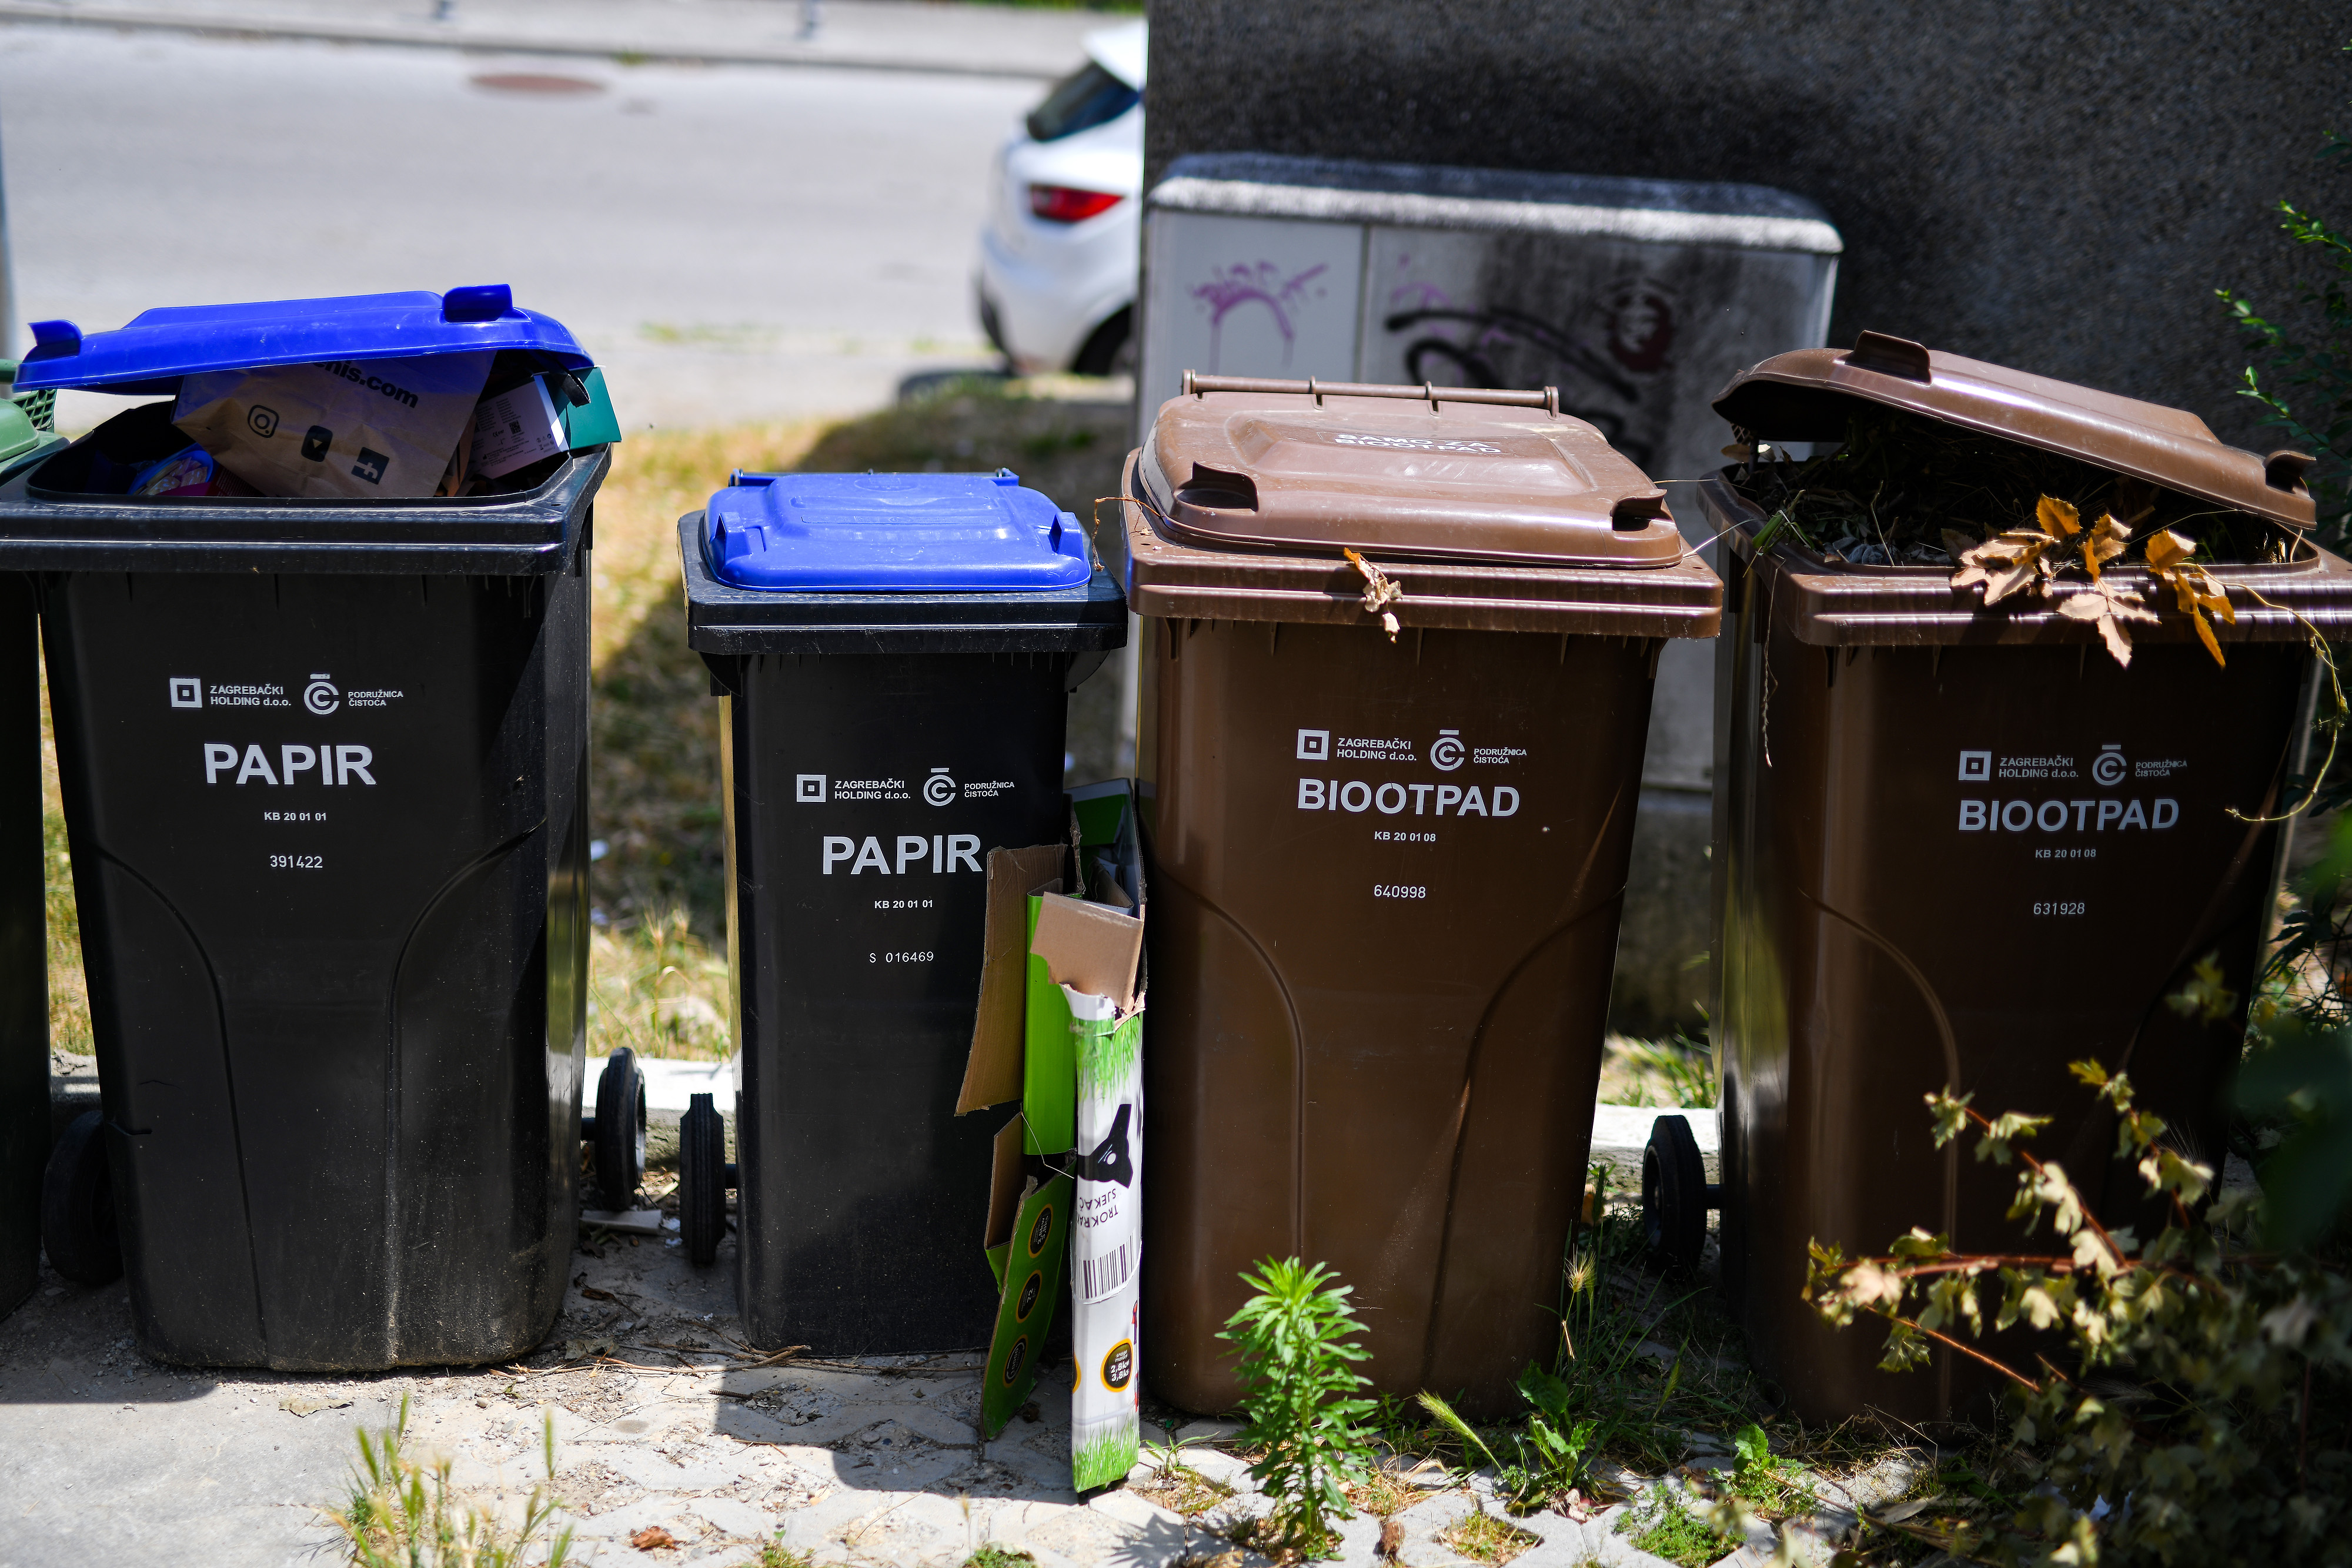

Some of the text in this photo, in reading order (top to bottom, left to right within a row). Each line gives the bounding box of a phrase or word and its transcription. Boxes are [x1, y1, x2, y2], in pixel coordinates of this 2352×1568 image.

[1338, 433, 1434, 444] SAMO
[1334, 438, 1501, 453] BIOOTPAD
[209, 683, 283, 695] ZAGREBAČKI
[348, 689, 404, 699] PODRUŽNICA
[210, 696, 292, 706] HOLDING d.o.o.
[348, 698, 387, 707] ČISTOĆA
[1337, 737, 1411, 751] ZAGREBAČKI
[1337, 748, 1417, 761] HOLDING d.o.o.
[1474, 747, 1527, 757] PODRUŽNICA
[203, 743, 377, 785] PAPIR
[1473, 754, 1509, 764] ČISTOĆA
[2000, 755, 2073, 767] ZAGREBAČKI
[2136, 759, 2187, 770] PODRUŽNICA
[1999, 768, 2079, 778] HOLDING d.o.o.
[2135, 768, 2170, 777] ČISTOĆA
[834, 778, 904, 789] ZAGREBAČKI
[964, 780, 1015, 791] PODRUŽNICA
[834, 791, 911, 800] HOLDING d.o.o.
[964, 788, 999, 798] ČISTOĆA
[1298, 778, 1520, 817] BIOOTPAD
[264, 812, 326, 821] KB 20 01 01
[1958, 798, 2179, 832] BIOOTPAD
[1374, 831, 1436, 842] KB 20 01 08
[823, 834, 983, 875] PAPIR
[2035, 849, 2096, 858] KB 20 01 08
[269, 855, 323, 868] 391422
[1374, 884, 1426, 899] 640998
[874, 900, 933, 909] KB 20 01 01
[2033, 902, 2085, 915] 631928
[869, 951, 934, 964] S 016469
[1079, 1188, 1117, 1211] SJEKAČ
